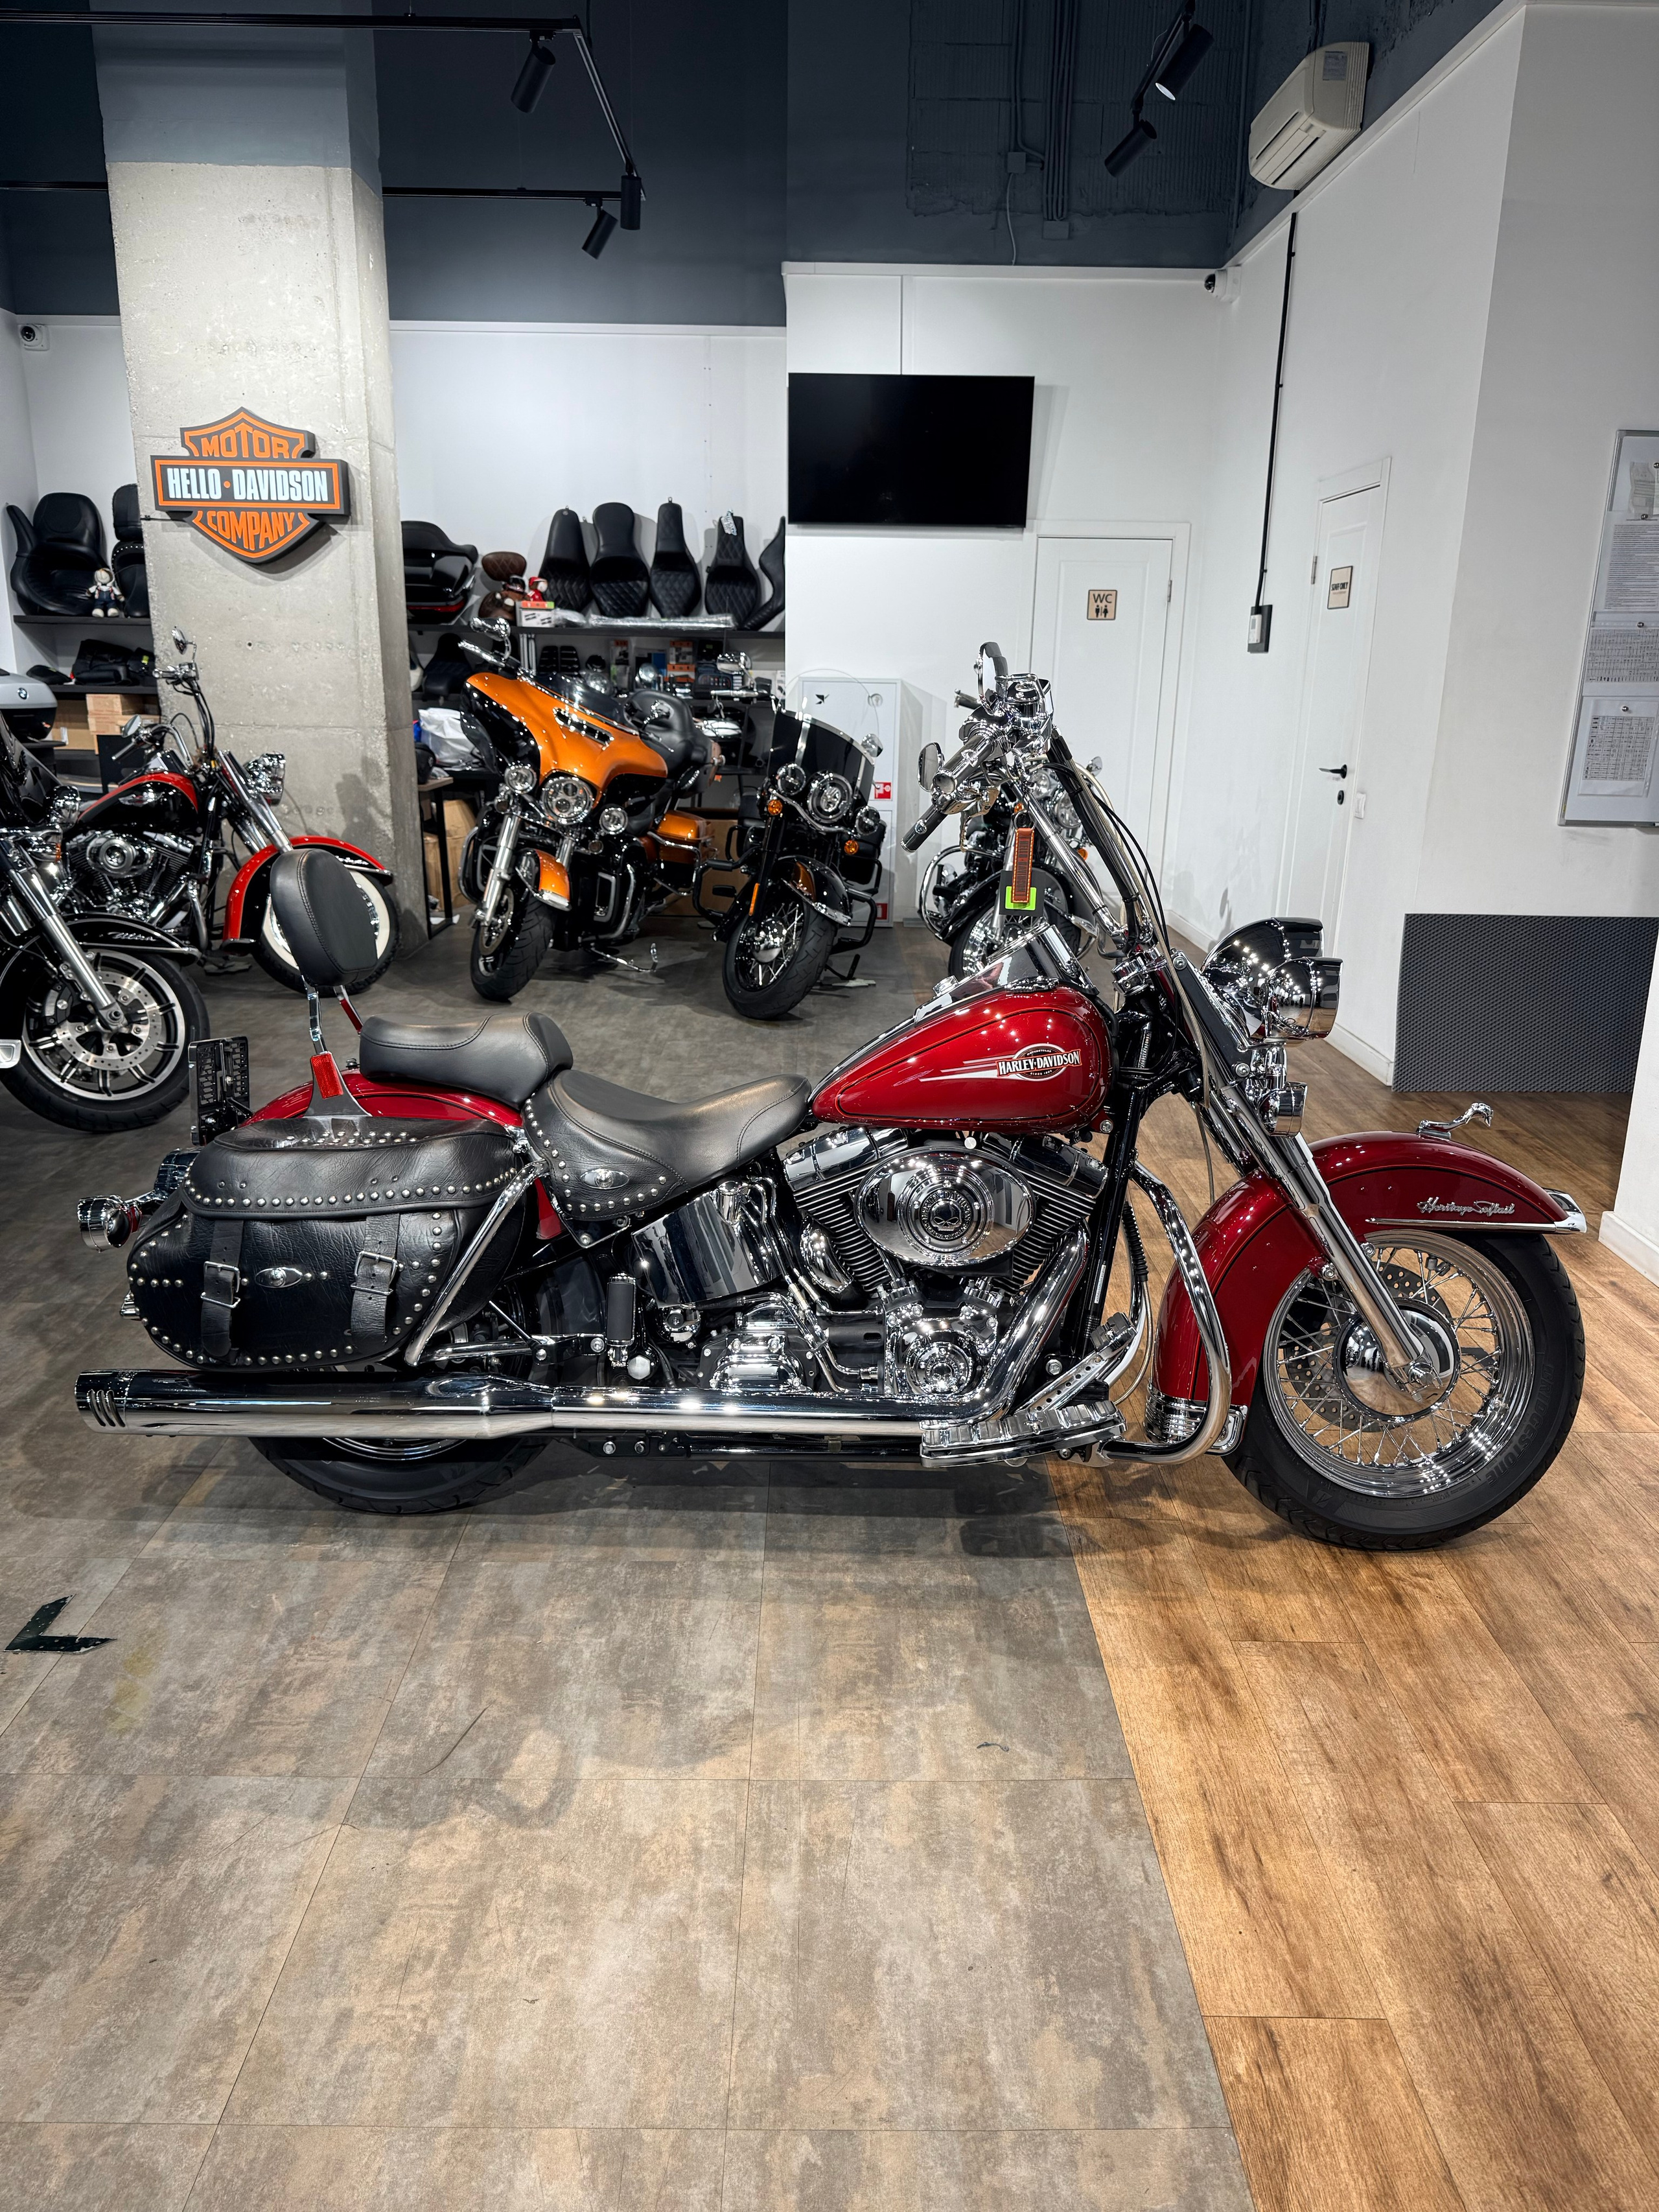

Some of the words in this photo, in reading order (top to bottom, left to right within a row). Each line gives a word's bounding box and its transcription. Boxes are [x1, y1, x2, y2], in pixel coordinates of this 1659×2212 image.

[201, 422, 290, 458] MOTOR
[167, 468, 222, 499] HELLO
[232, 469, 328, 501] DAVIDSON
[207, 511, 295, 550] COMPANY
[1093, 594, 1112, 603] WC
[1417, 1196, 1474, 1216] Heritage
